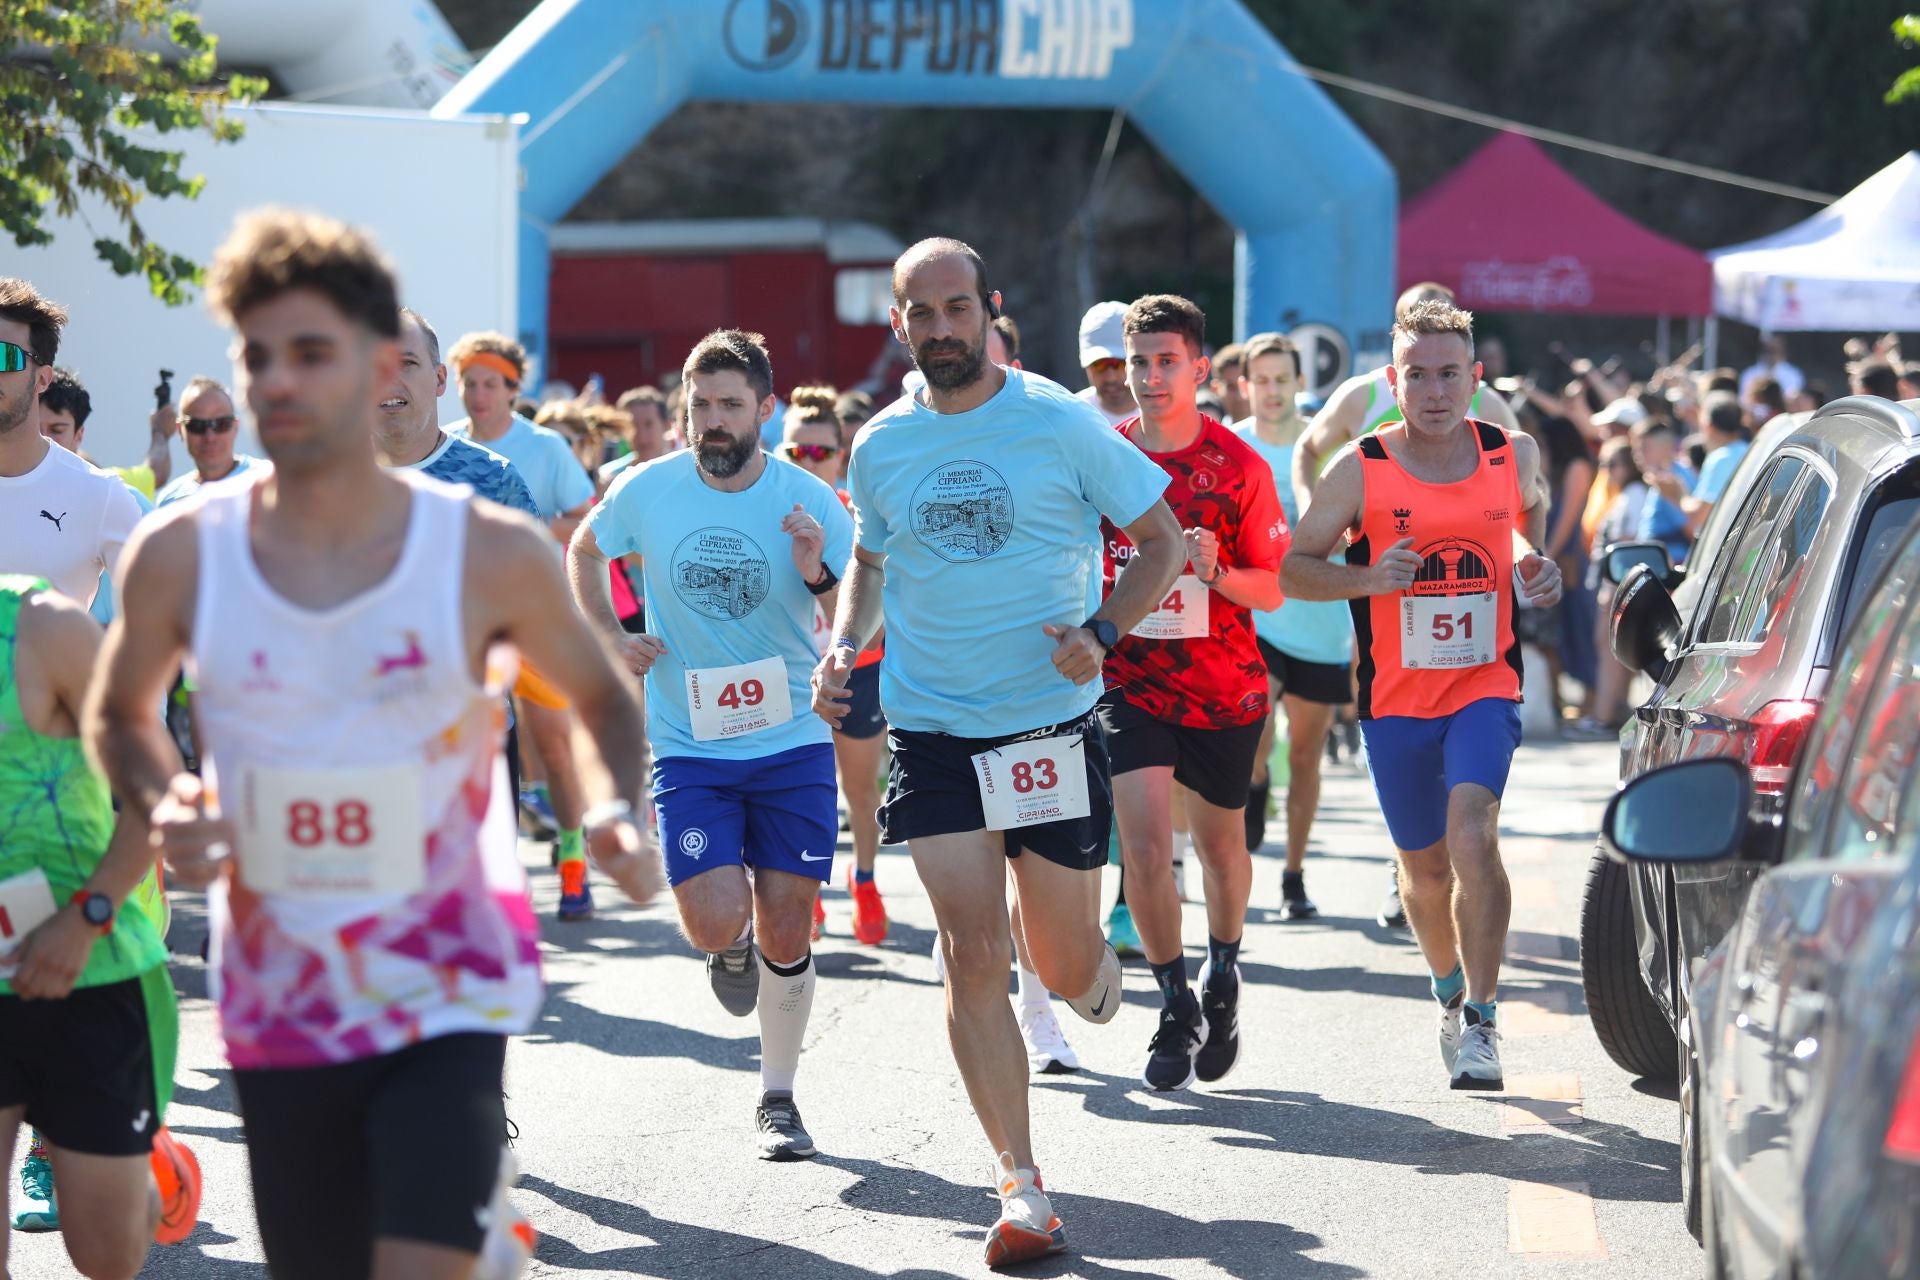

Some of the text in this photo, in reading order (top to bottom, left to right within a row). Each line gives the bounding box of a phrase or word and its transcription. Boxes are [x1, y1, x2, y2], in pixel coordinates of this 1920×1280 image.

[938, 475, 982, 486] CIPRIANO
[699, 540, 742, 551] CIPRIANO
[1419, 581, 1484, 591] MAZARAMBROZ
[1431, 612, 1473, 641] 51
[692, 673, 702, 710] CARRERA
[717, 679, 764, 709] 49
[722, 719, 767, 732] CIPRIANO
[980, 756, 995, 794] CARRERA
[1011, 758, 1059, 794] 83
[286, 797, 372, 848] 88
[1018, 807, 1060, 819] CIPRIANO
